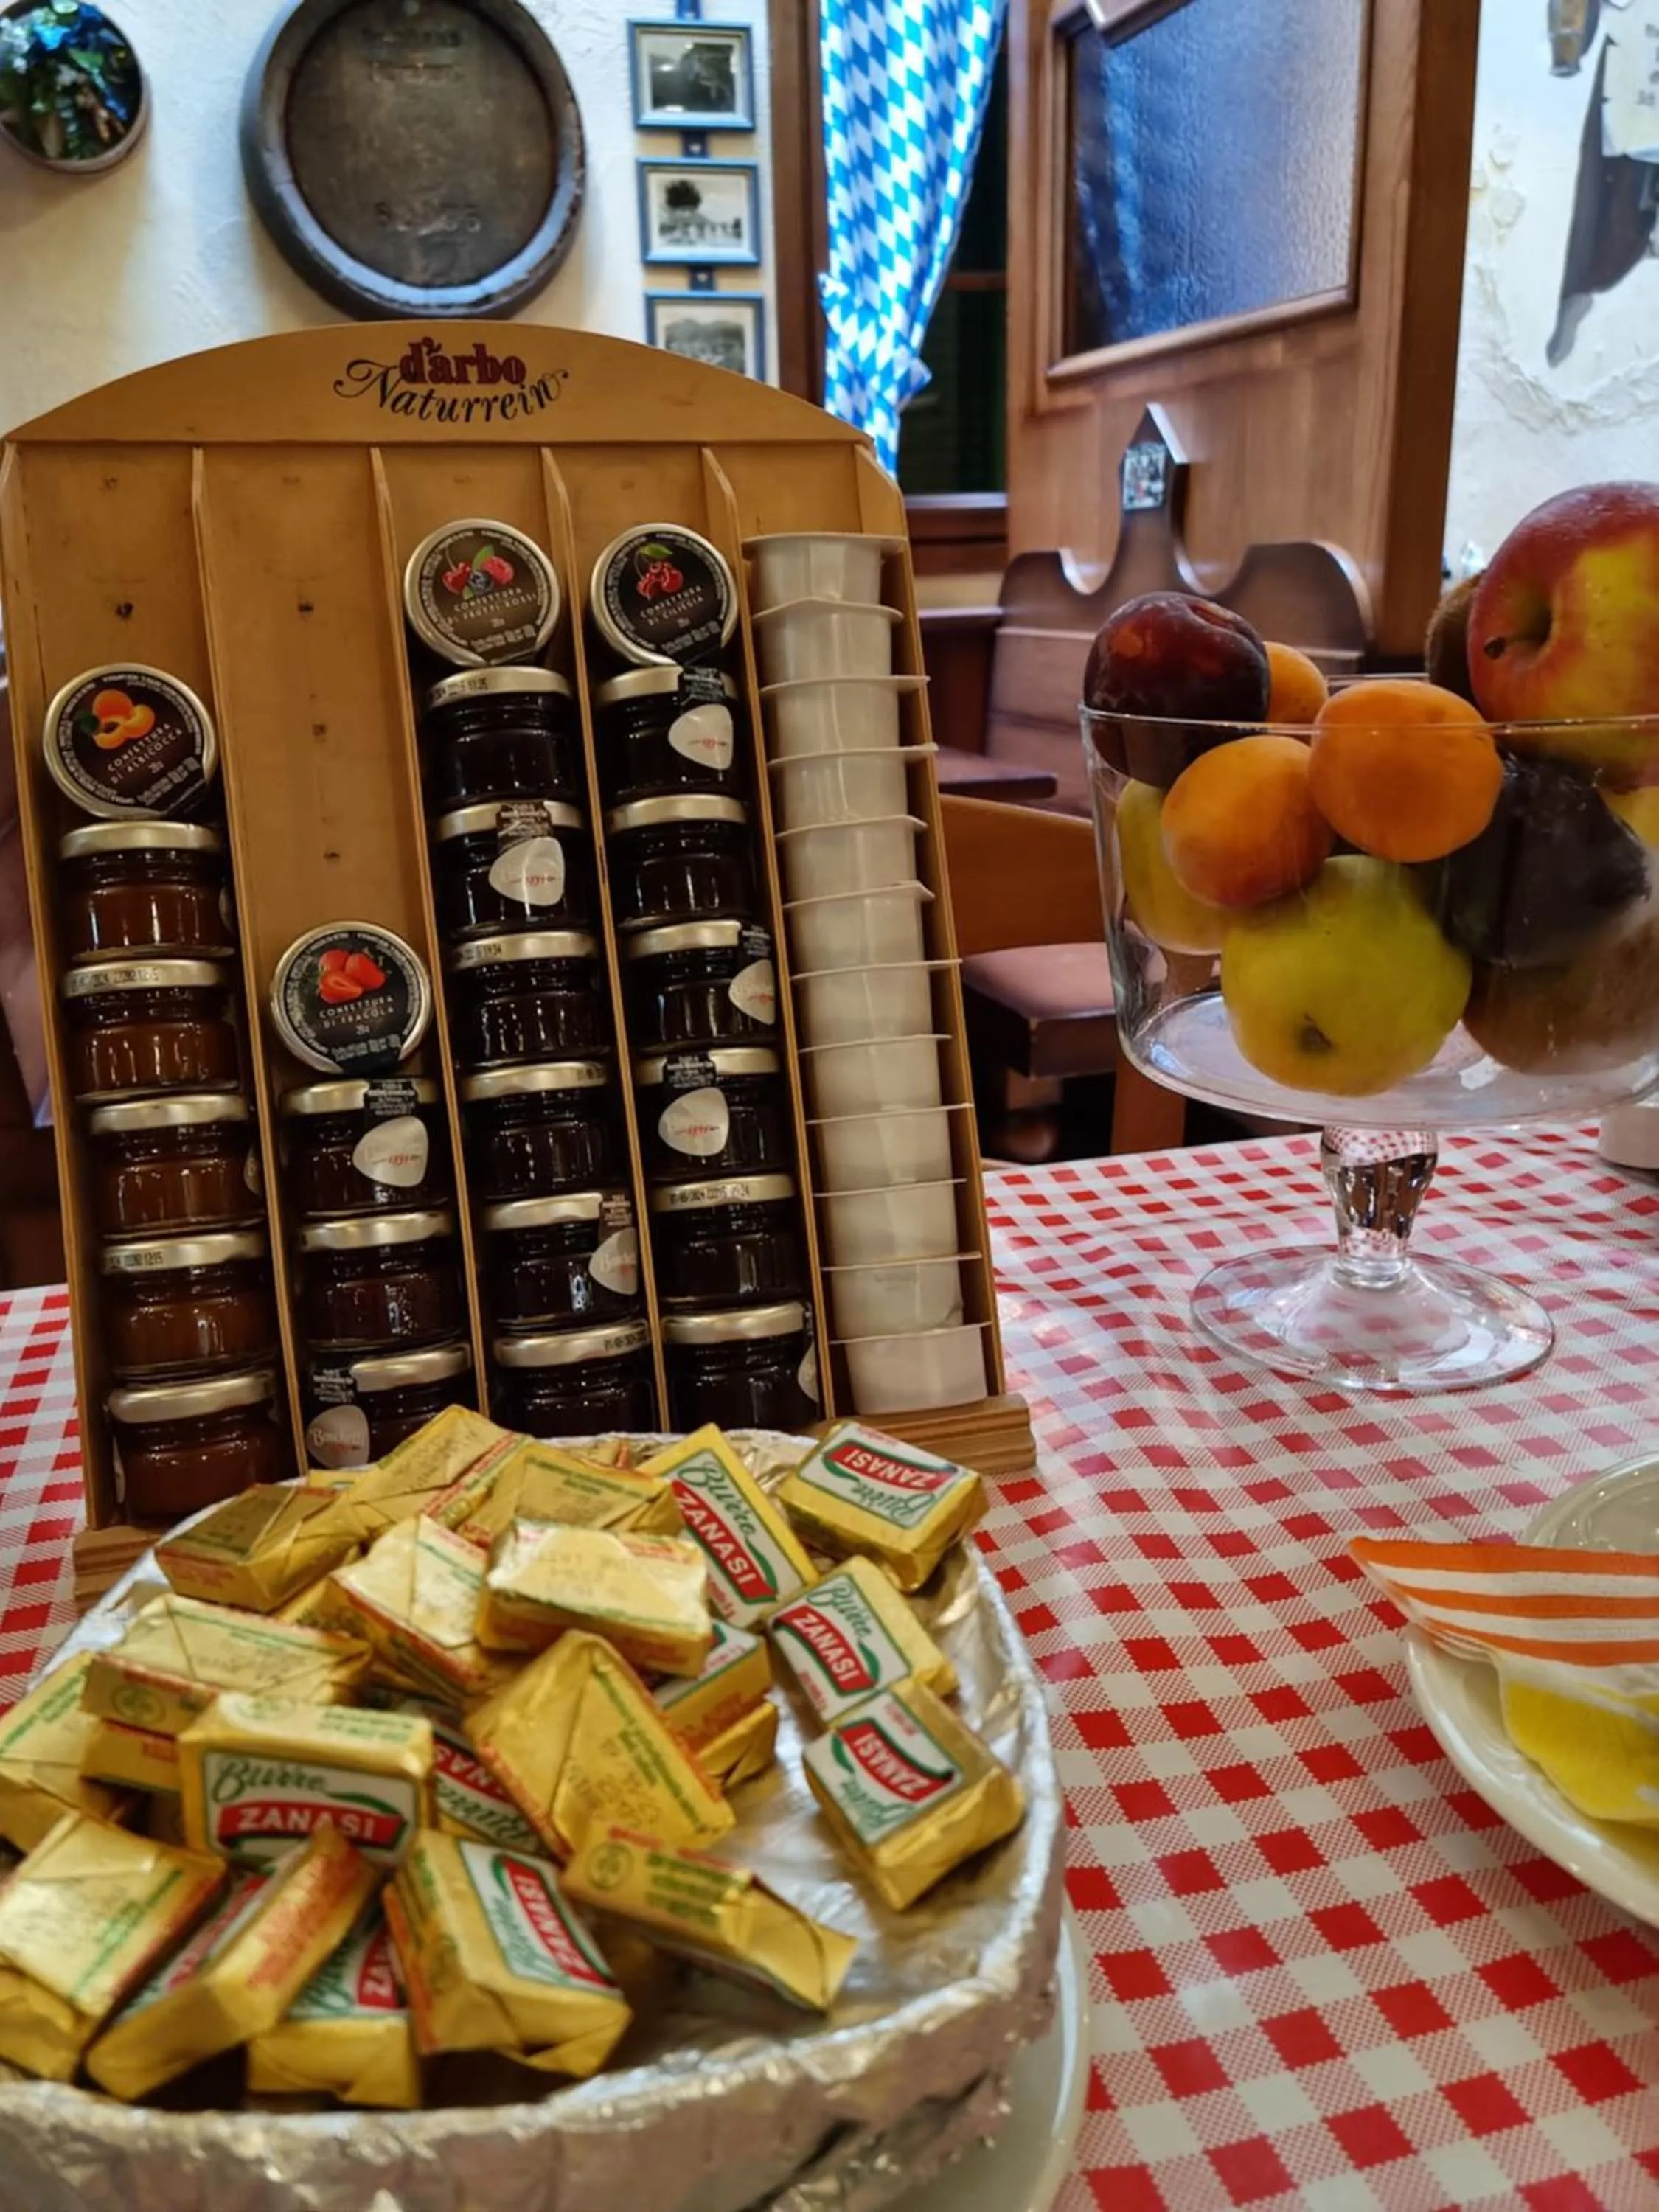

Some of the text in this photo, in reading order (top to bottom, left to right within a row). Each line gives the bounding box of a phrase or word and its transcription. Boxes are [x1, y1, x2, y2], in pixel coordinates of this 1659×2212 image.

[333, 358, 570, 423] Naturrein
[844, 1447, 937, 1488] ZANASI
[674, 1493, 757, 1585] ZANASI
[793, 1613, 860, 1682] ZANASI
[852, 1732, 931, 1794] ZANASI
